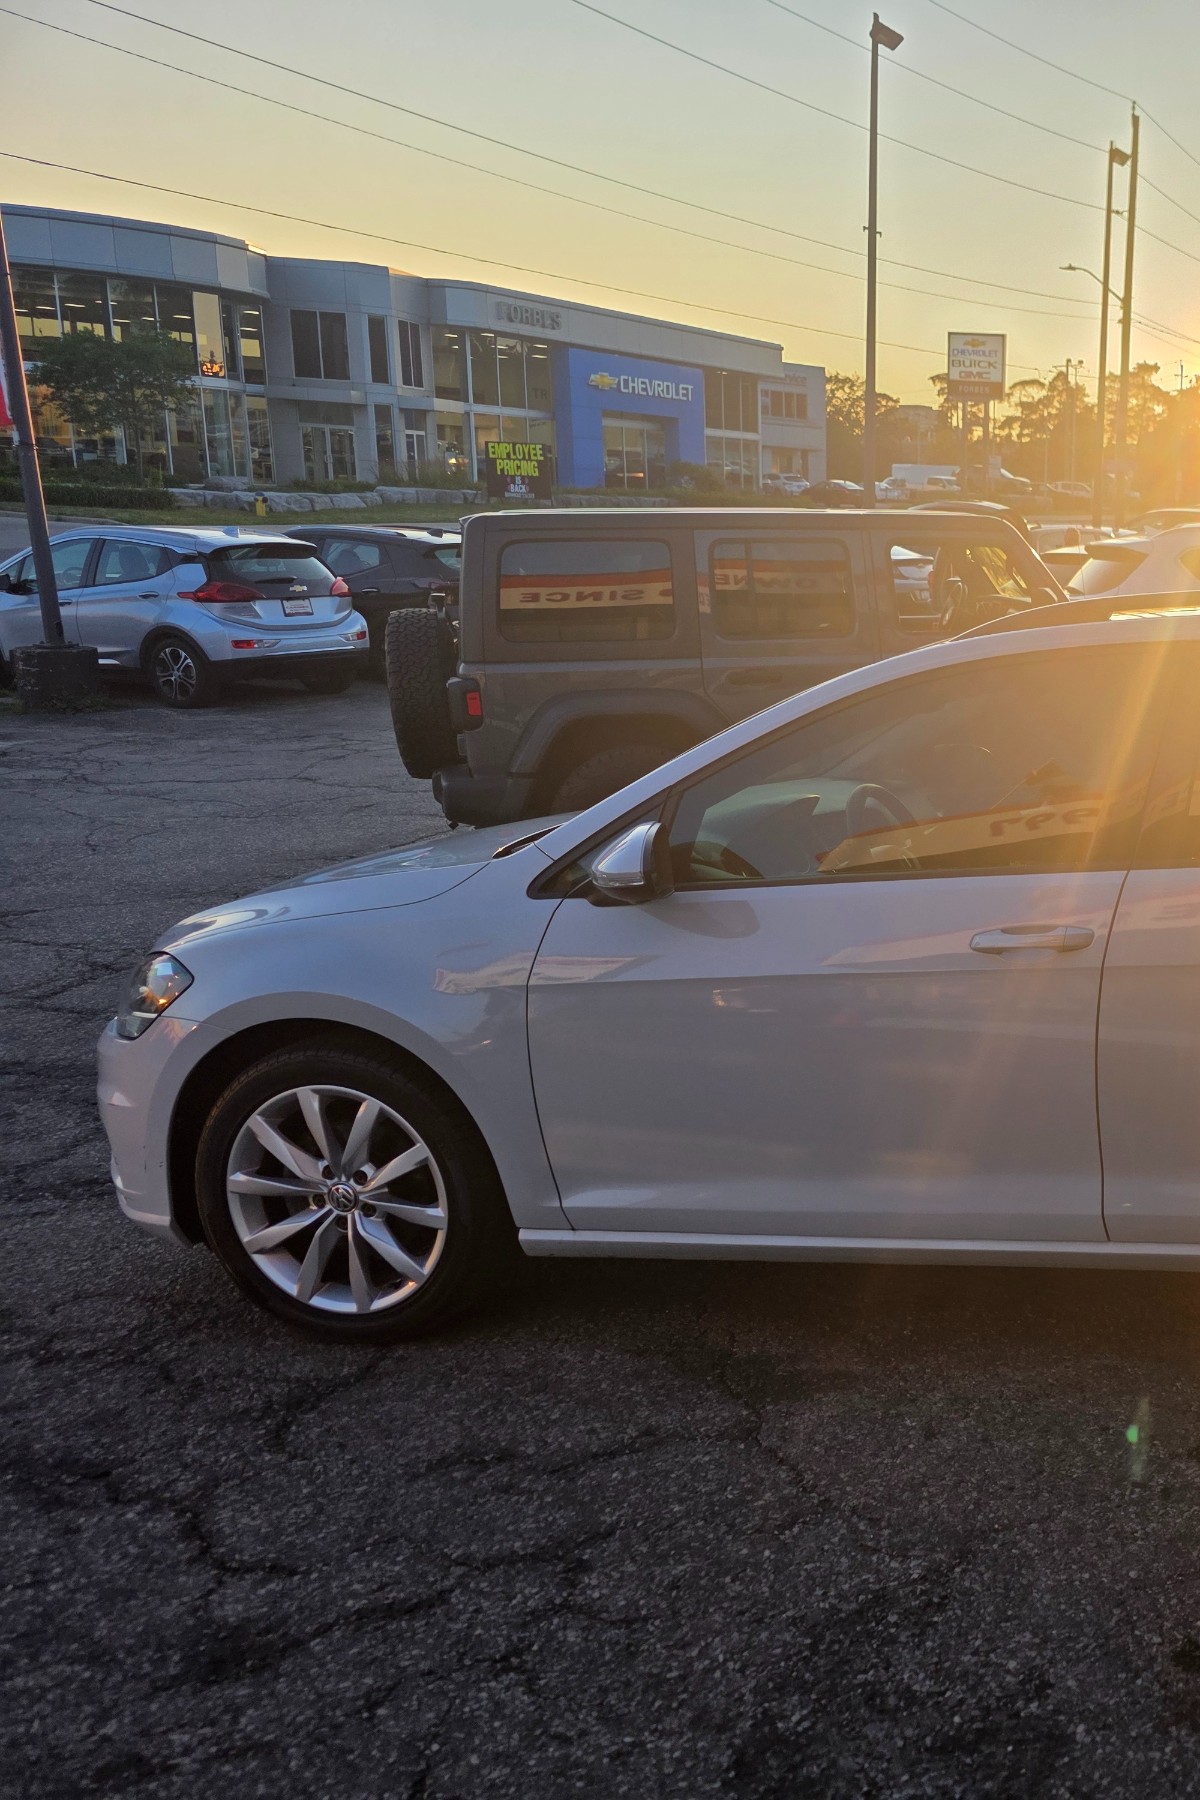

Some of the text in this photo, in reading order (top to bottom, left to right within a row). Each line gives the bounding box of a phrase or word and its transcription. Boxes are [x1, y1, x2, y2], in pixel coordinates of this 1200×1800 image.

[952, 348, 998, 358] CHEVROLET
[952, 359, 998, 369] BUICK
[620, 375, 694, 401] CHEVROLET
[488, 442, 544, 460] EMPLOYEE
[497, 459, 539, 477] PRICING
[515, 476, 522, 484] IS
[510, 484, 526, 492] BACK
